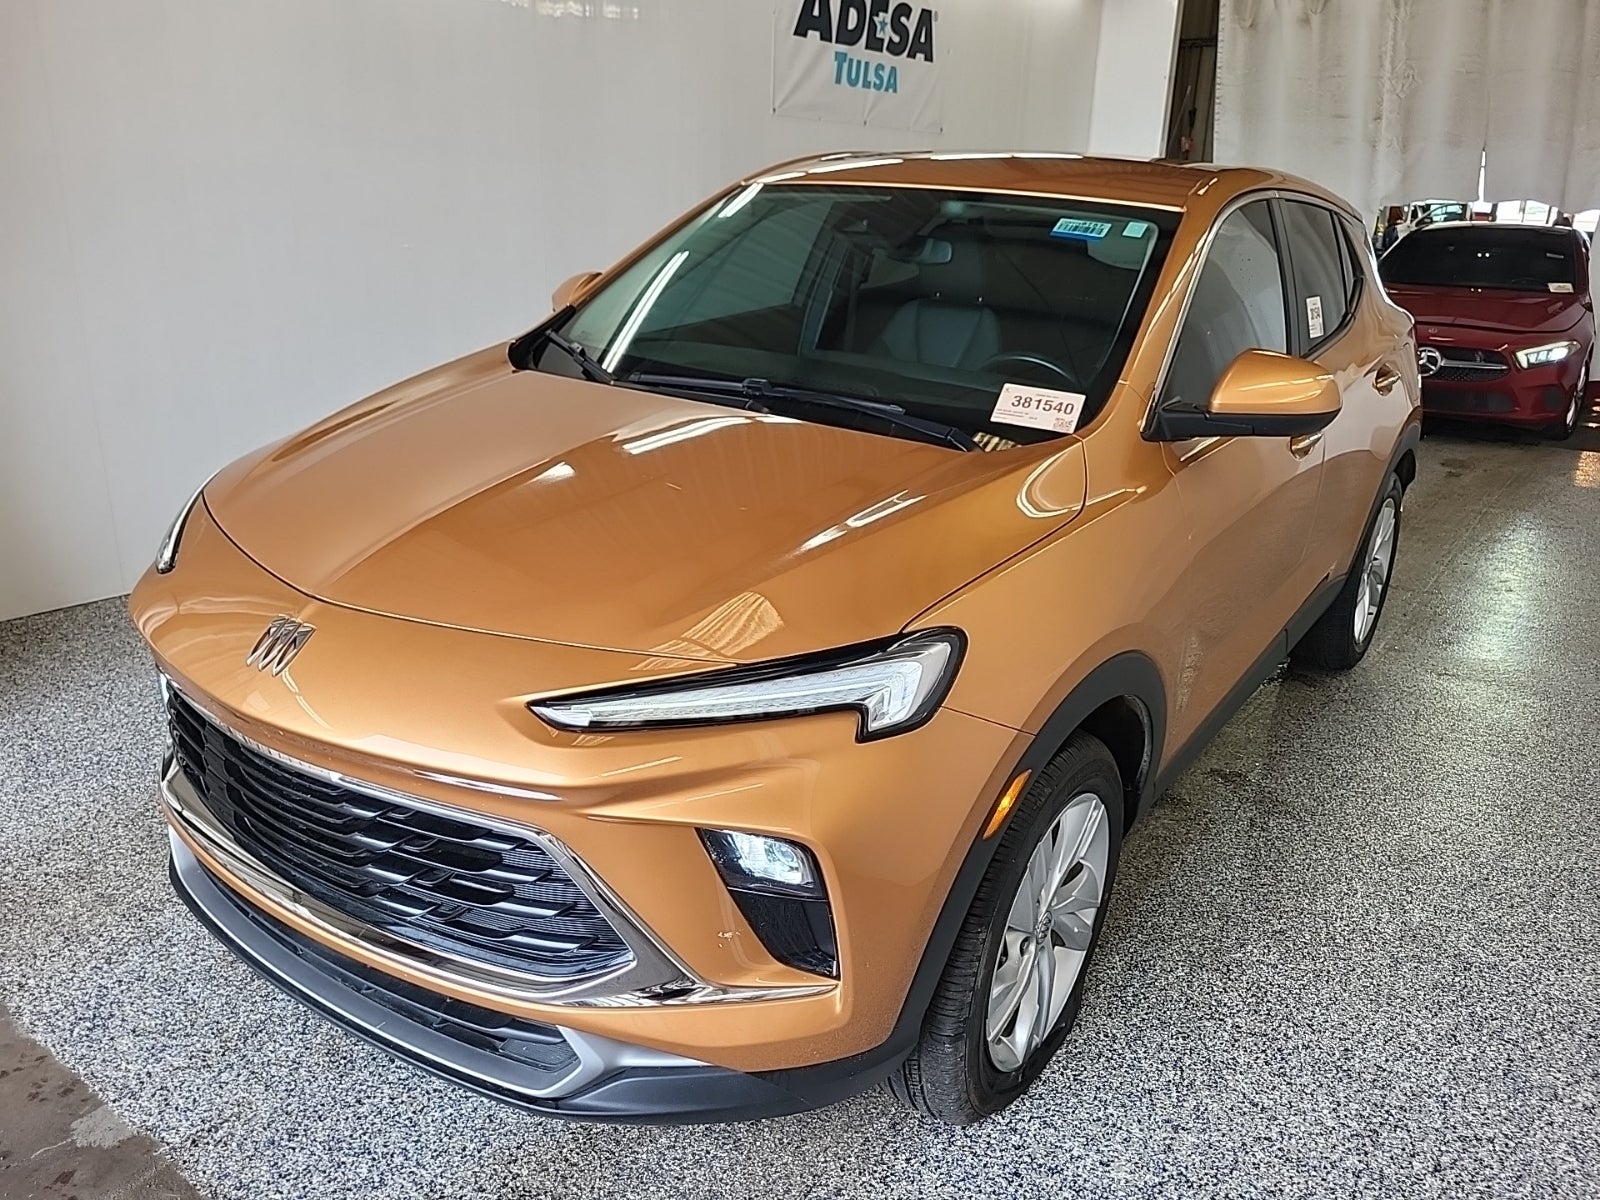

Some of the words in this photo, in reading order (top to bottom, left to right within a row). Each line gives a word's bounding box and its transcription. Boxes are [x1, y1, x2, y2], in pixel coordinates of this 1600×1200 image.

[793, 0, 934, 62] ADESA
[834, 51, 898, 93] TULSA
[1011, 395, 1075, 415] 381540
